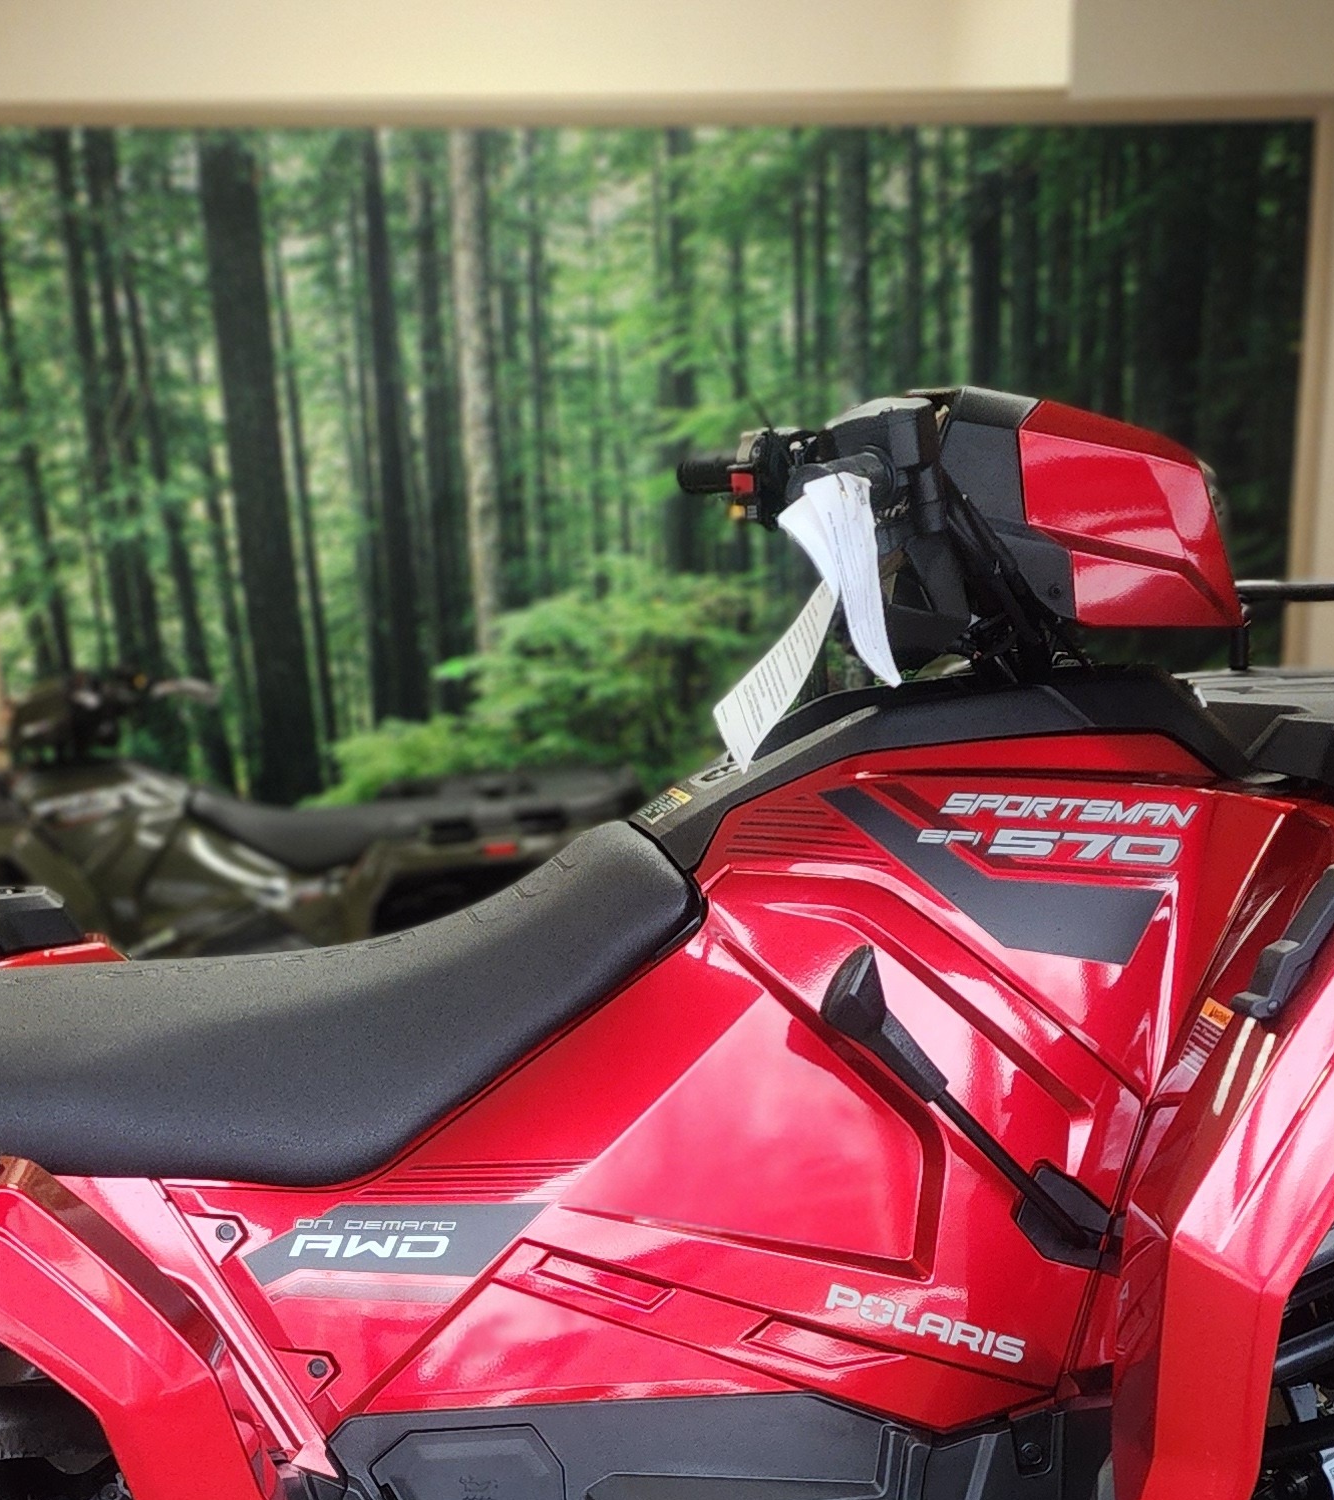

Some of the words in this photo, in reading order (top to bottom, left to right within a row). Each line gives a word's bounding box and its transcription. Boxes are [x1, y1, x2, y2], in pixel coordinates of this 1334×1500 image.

[938, 791, 1198, 828] SPORTSMAN
[916, 829, 983, 847] EFI
[987, 828, 1183, 865] 570
[294, 1217, 334, 1230] ON
[343, 1219, 458, 1232] DEMAND
[288, 1233, 450, 1259] AWD
[824, 1282, 1027, 1364] POLARIS
